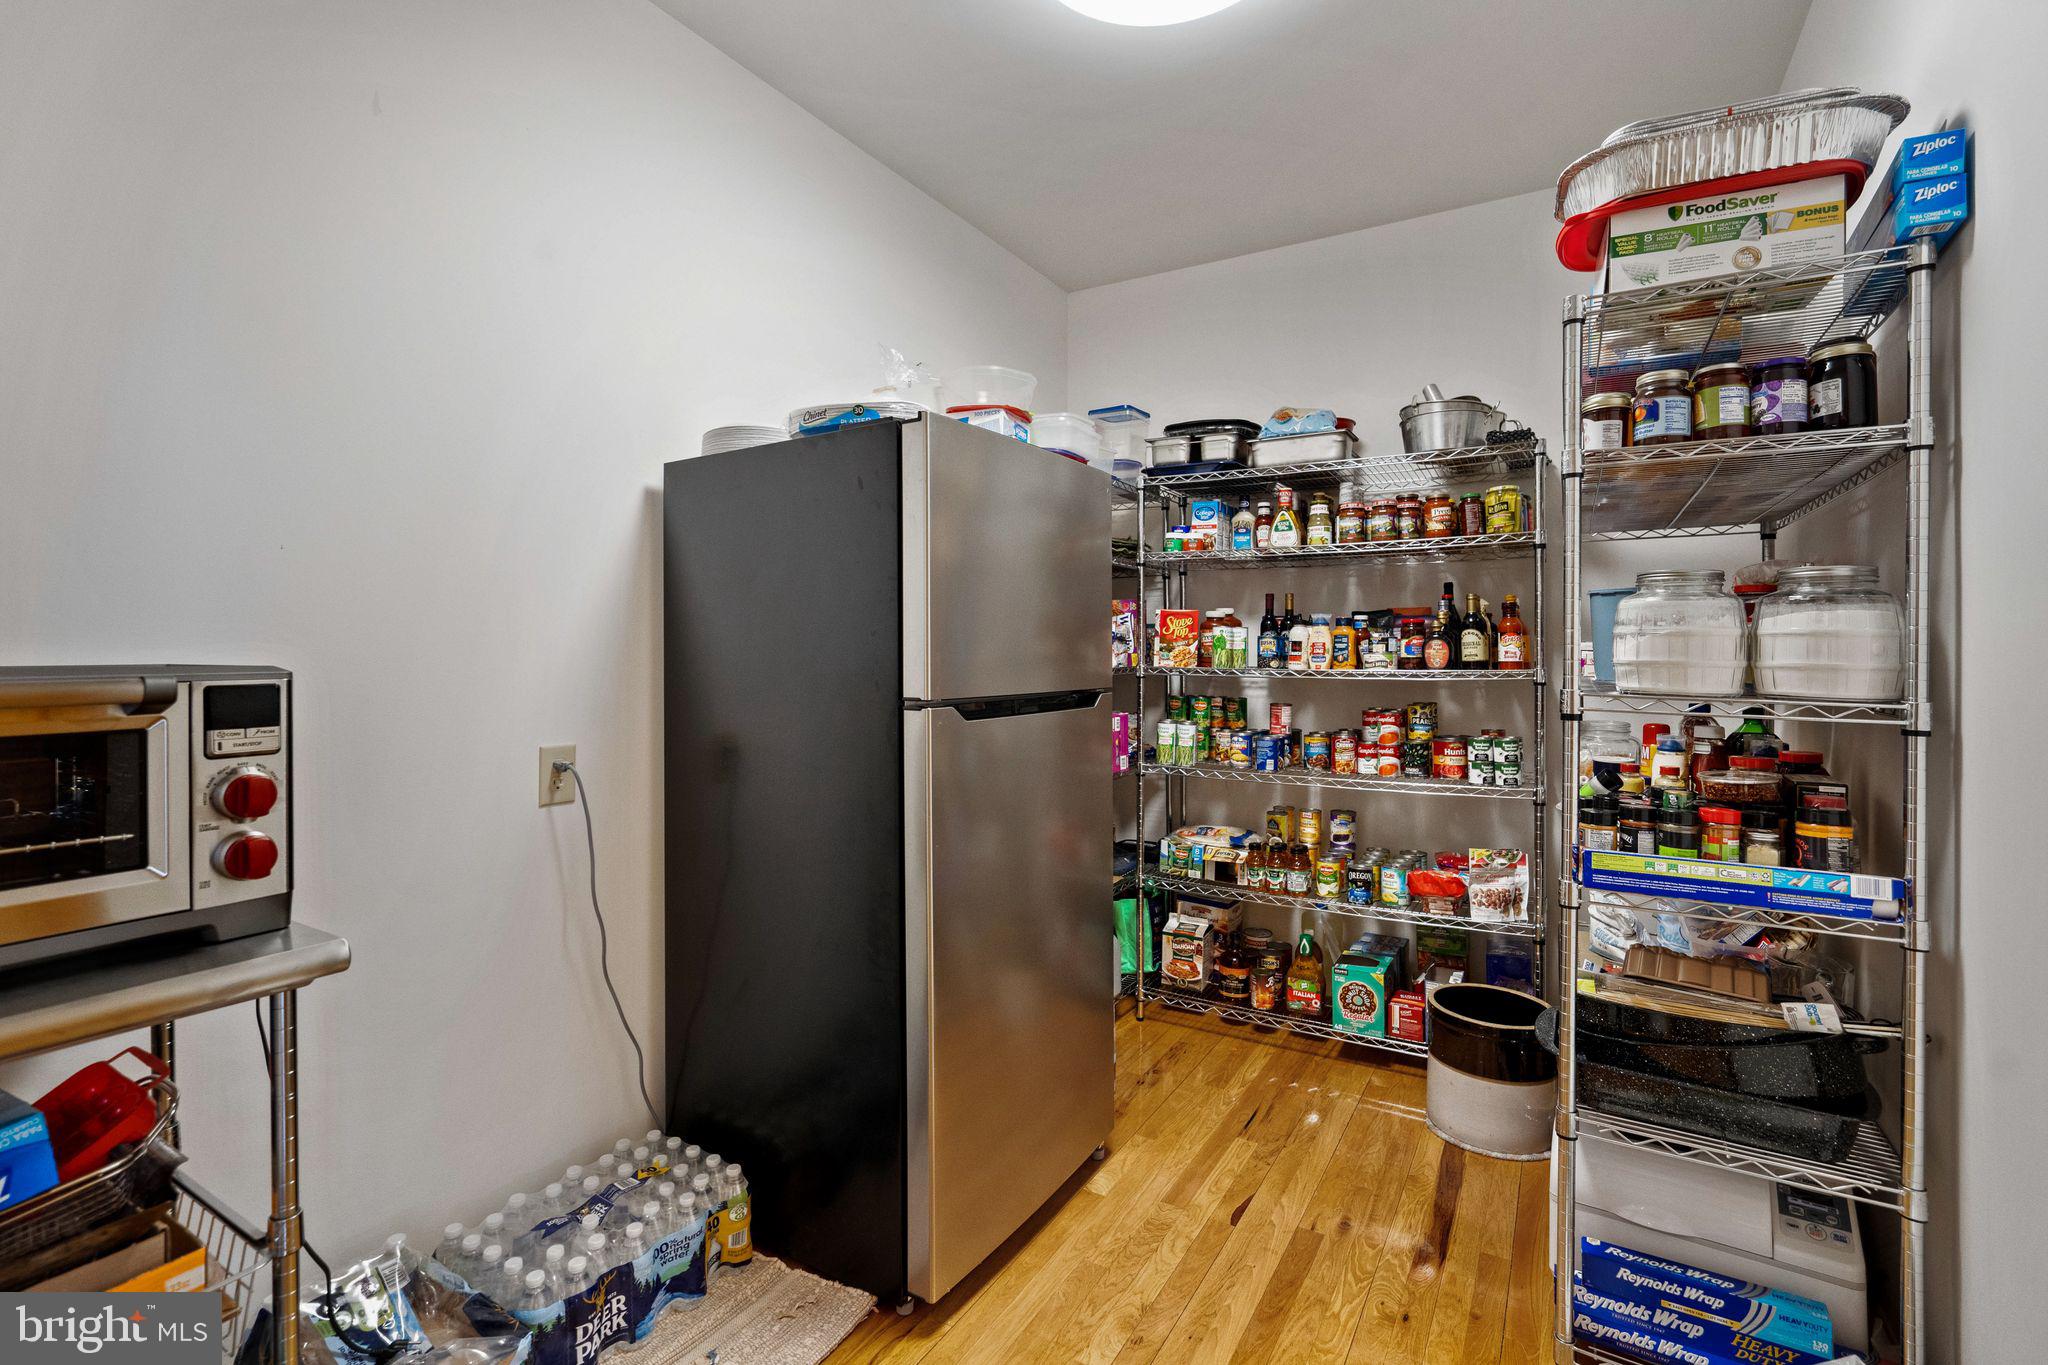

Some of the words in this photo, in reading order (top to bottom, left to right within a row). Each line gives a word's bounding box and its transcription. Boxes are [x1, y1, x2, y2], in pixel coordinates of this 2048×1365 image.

[1913, 135, 1956, 157] Ziploc
[1915, 181, 1957, 202] Ziploc
[1686, 193, 1777, 217] FoodSaver
[1797, 205, 1839, 217] BONUS
[803, 408, 828, 421] Chinet
[854, 406, 864, 414] 30
[1163, 616, 1194, 634] Stove
[1173, 627, 1189, 639] Top
[1348, 871, 1372, 880] OREGON
[1172, 942, 1195, 950] IDAHOAN
[1293, 990, 1316, 999] ITALIAN
[1342, 1008, 1375, 1023] Regular
[13, 1126, 42, 1141] PARA
[706, 1216, 720, 1232] 40
[669, 1226, 704, 1250] natural
[659, 1243, 690, 1262] spring
[660, 1250, 690, 1268] water
[1605, 1247, 1683, 1274] Reynolds
[1685, 1269, 1735, 1289] Wrap
[1616, 1267, 1682, 1296] Reynolds
[1683, 1286, 1725, 1309] Wrap
[575, 1294, 628, 1346] DEER
[1573, 1284, 1652, 1321] Reynolds
[1653, 1308, 1705, 1338] Wrap
[575, 1312, 628, 1365] PARK
[1574, 1313, 1657, 1351] Reynolds
[1657, 1339, 1710, 1365] Wrap
[1731, 1333, 1800, 1363] HEAVY
